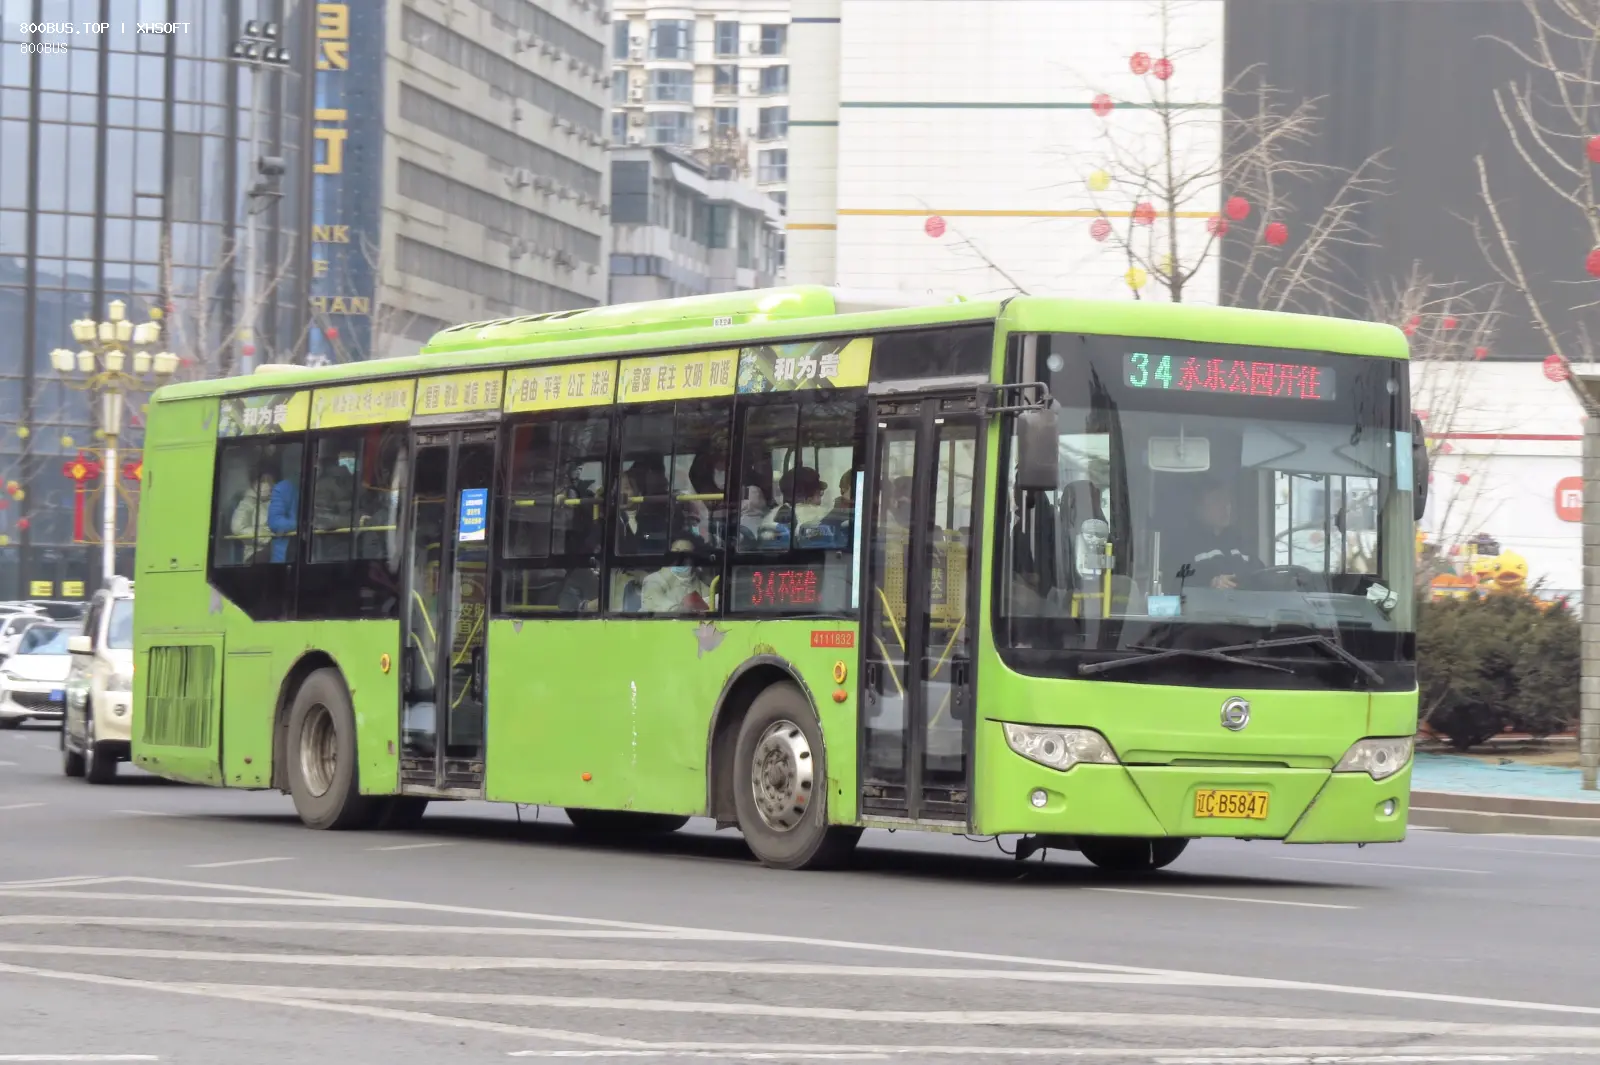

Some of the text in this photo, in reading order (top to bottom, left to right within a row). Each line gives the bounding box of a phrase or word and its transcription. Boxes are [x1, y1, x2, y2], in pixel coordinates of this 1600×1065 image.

[312, 224, 350, 243] NK
[312, 260, 329, 278] F
[310, 296, 370, 315] HAN
[631, 359, 731, 393] 富强 民主 文明 和谐
[774, 353, 840, 381] 和为贵
[1129, 352, 1321, 399] 34 永乐公园开往
[520, 370, 610, 402] 自由 平等 公正 法治
[243, 403, 288, 426] 和为贵
[813, 633, 852, 645] 4111832
